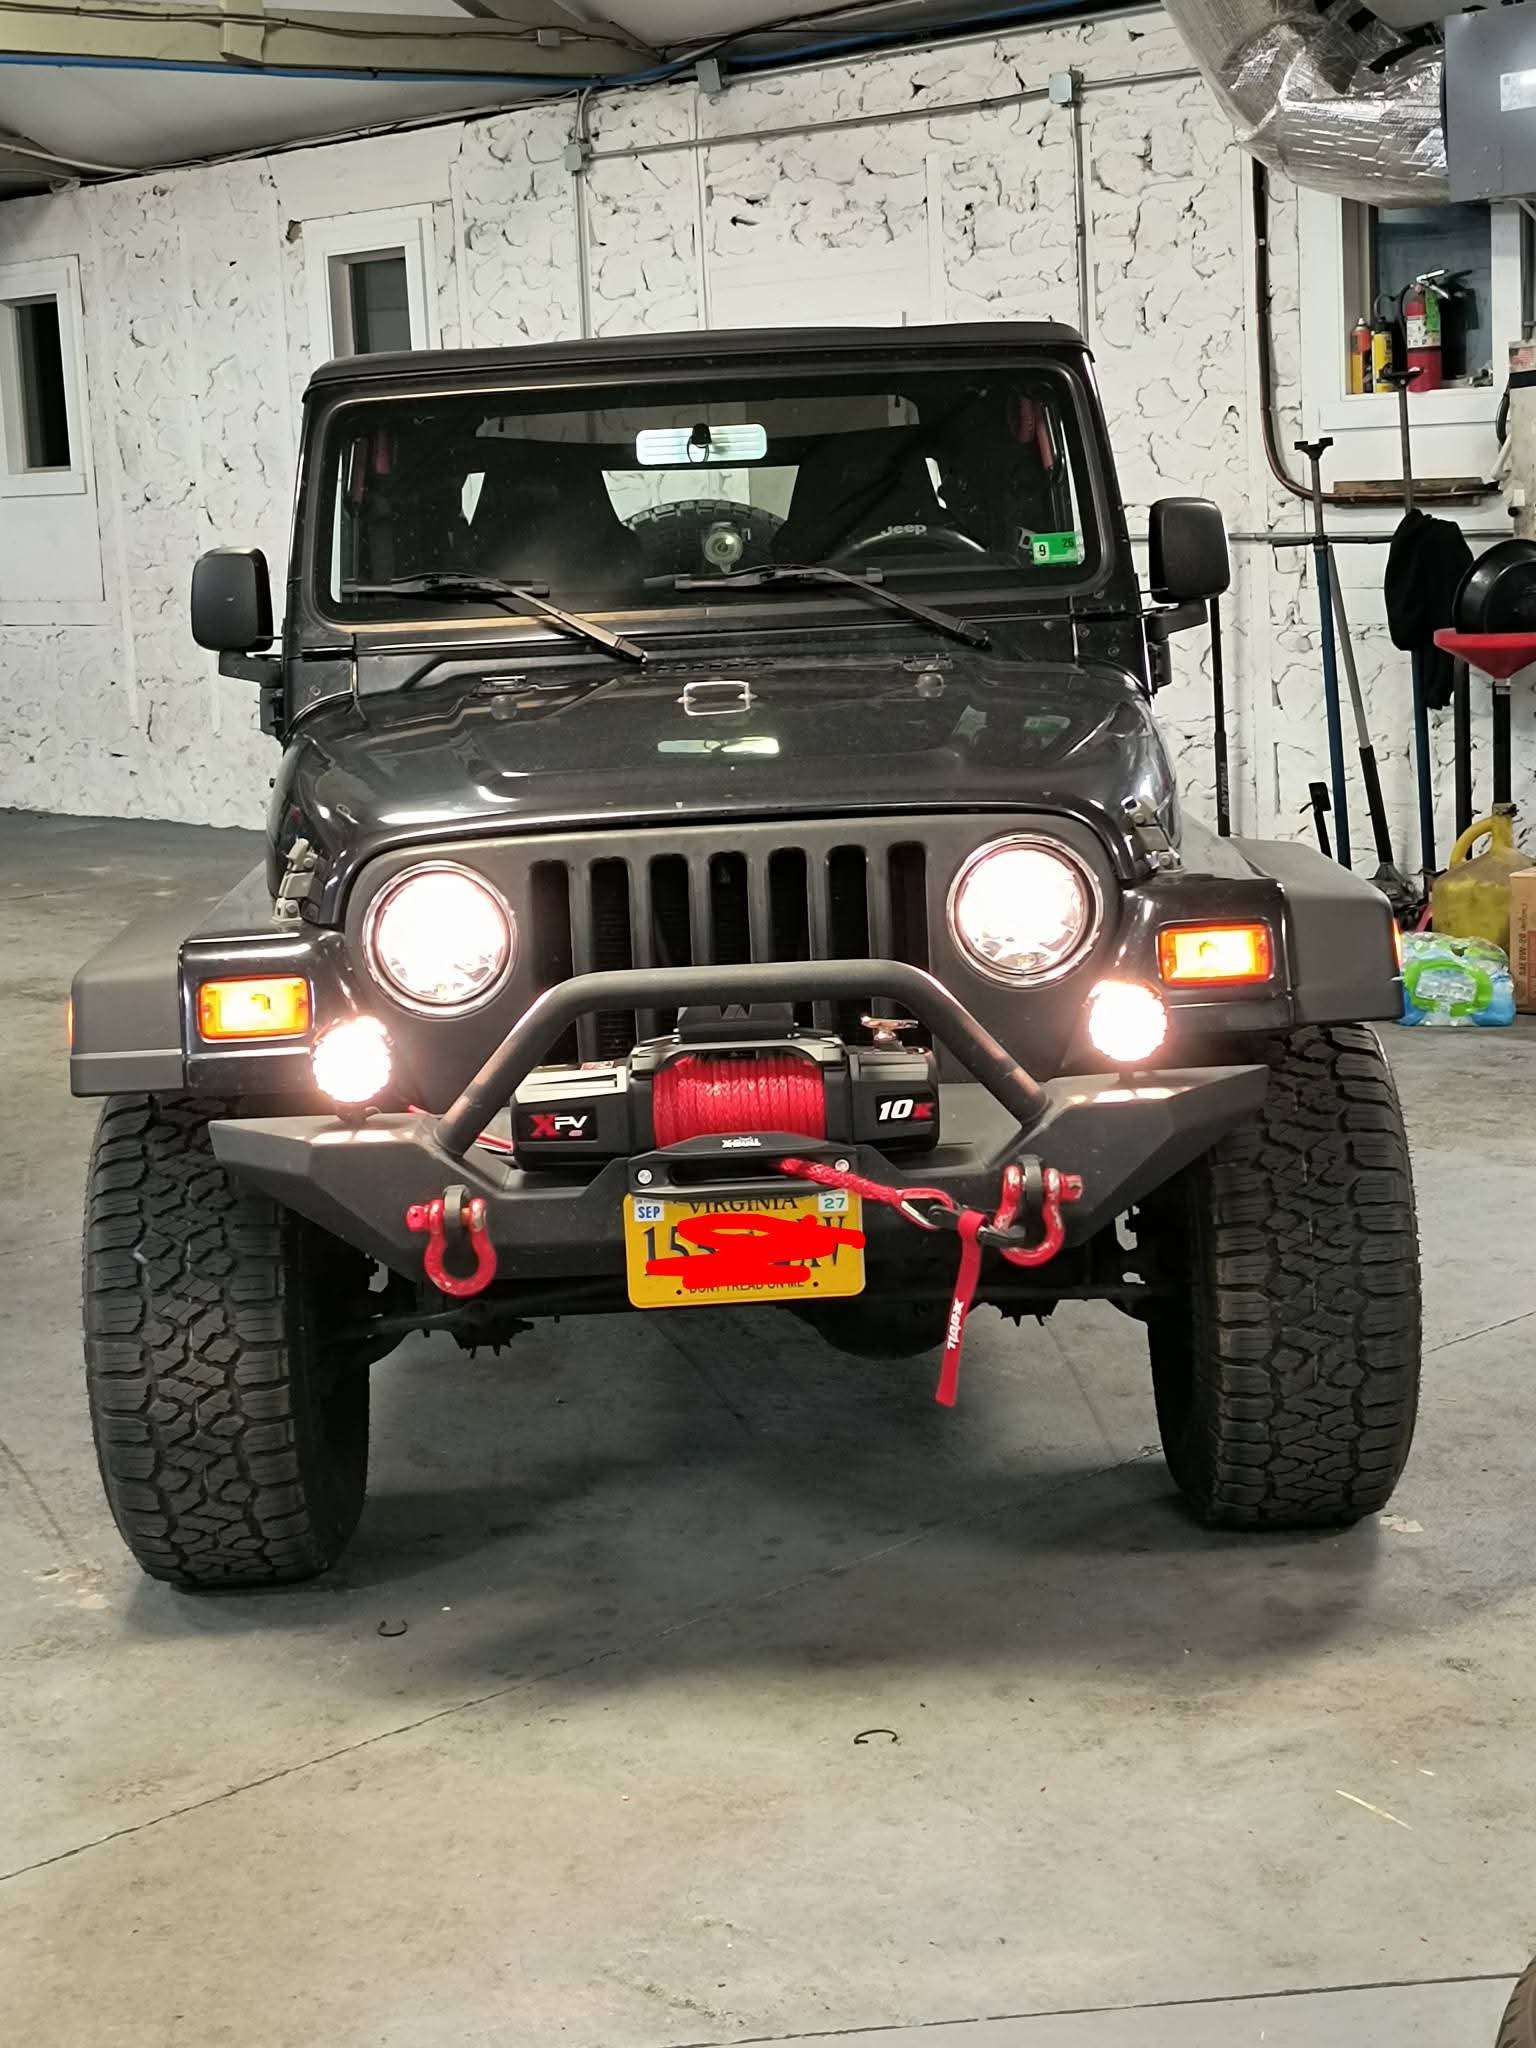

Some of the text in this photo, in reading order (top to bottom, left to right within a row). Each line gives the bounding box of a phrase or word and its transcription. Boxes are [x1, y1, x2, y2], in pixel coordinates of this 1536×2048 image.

[880, 524, 927, 536] Jeep
[1038, 544, 1047, 556] 9
[689, 1196, 798, 1214] VIRGINIA
[824, 1197, 845, 1209] 27
[638, 1206, 660, 1218] SEP
